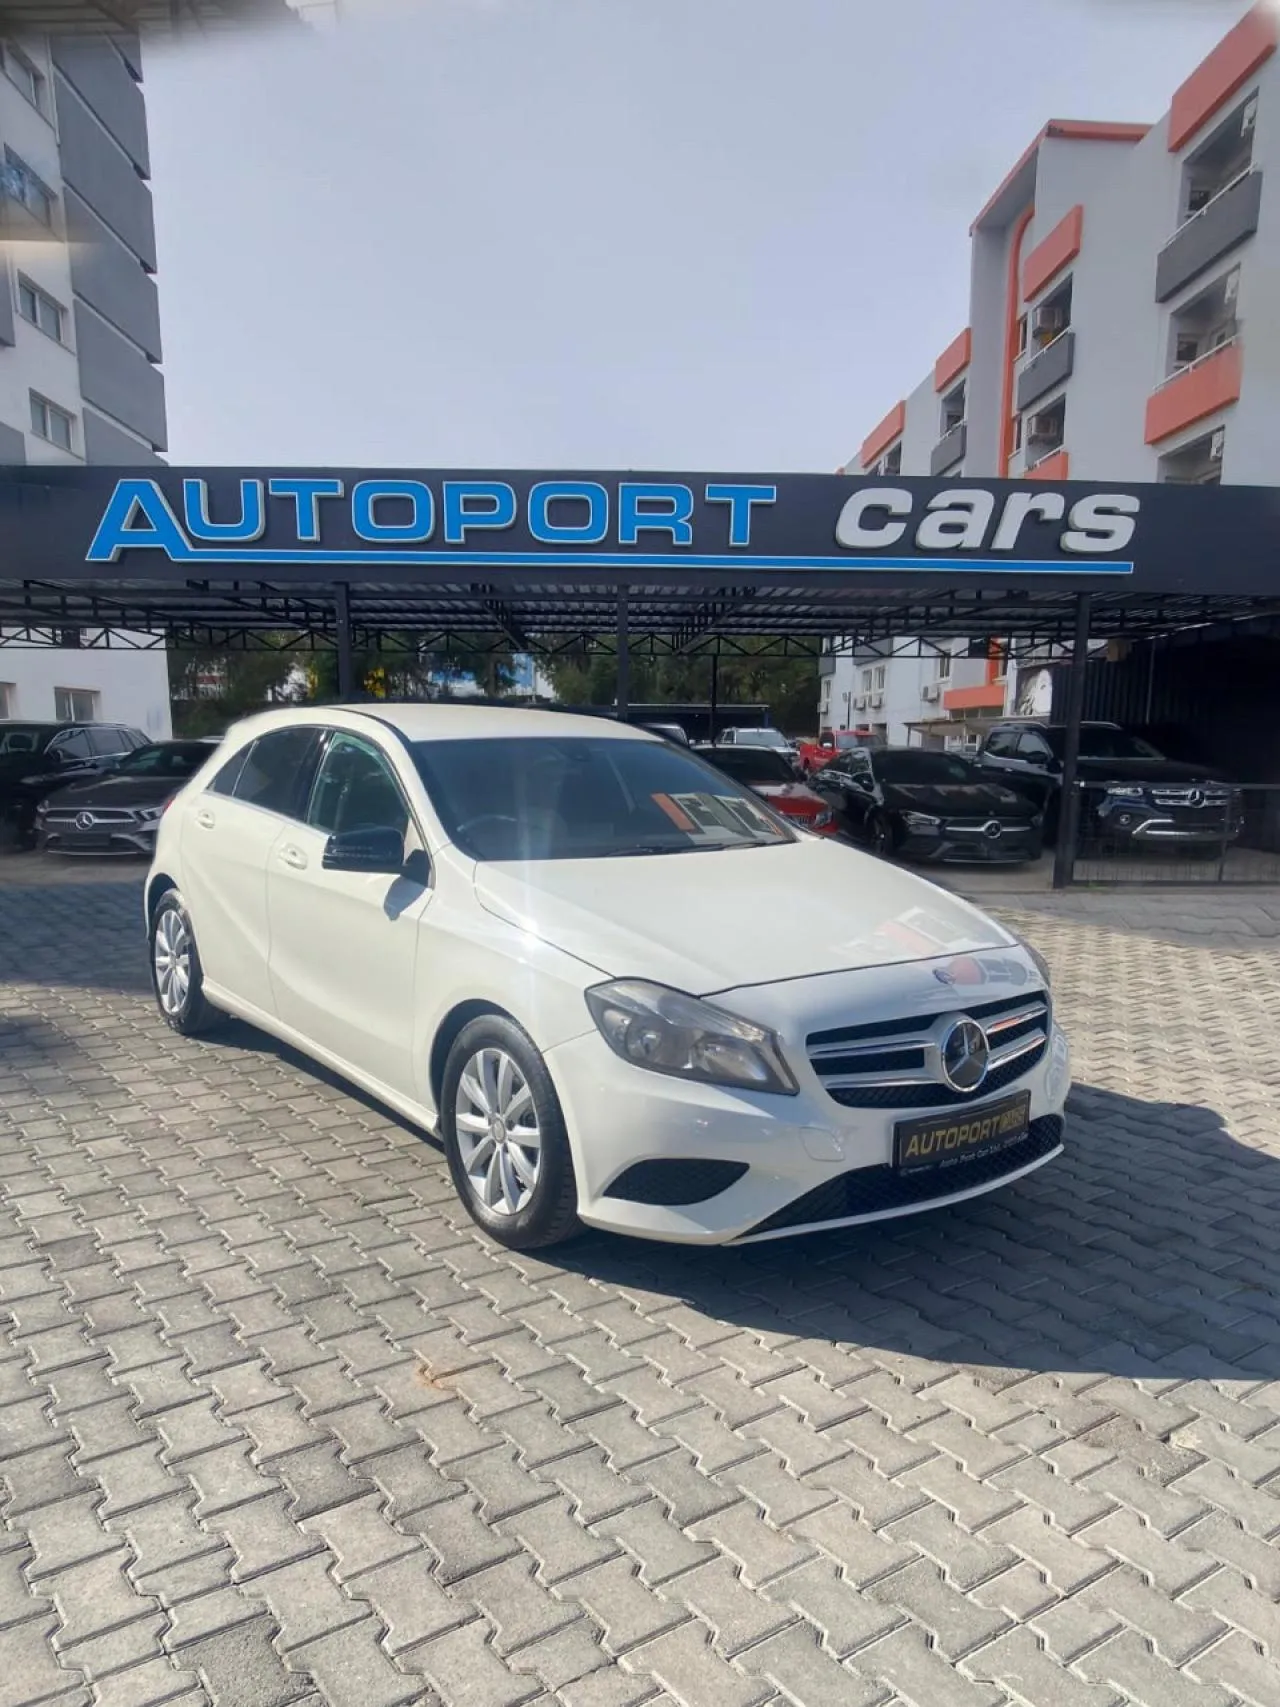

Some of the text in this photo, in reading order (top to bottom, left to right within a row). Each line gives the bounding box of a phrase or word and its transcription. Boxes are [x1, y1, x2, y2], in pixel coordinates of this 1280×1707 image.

[86, 478, 1141, 563] AUTOPORT cars
[905, 1116, 1000, 1157] AUTOPORT
